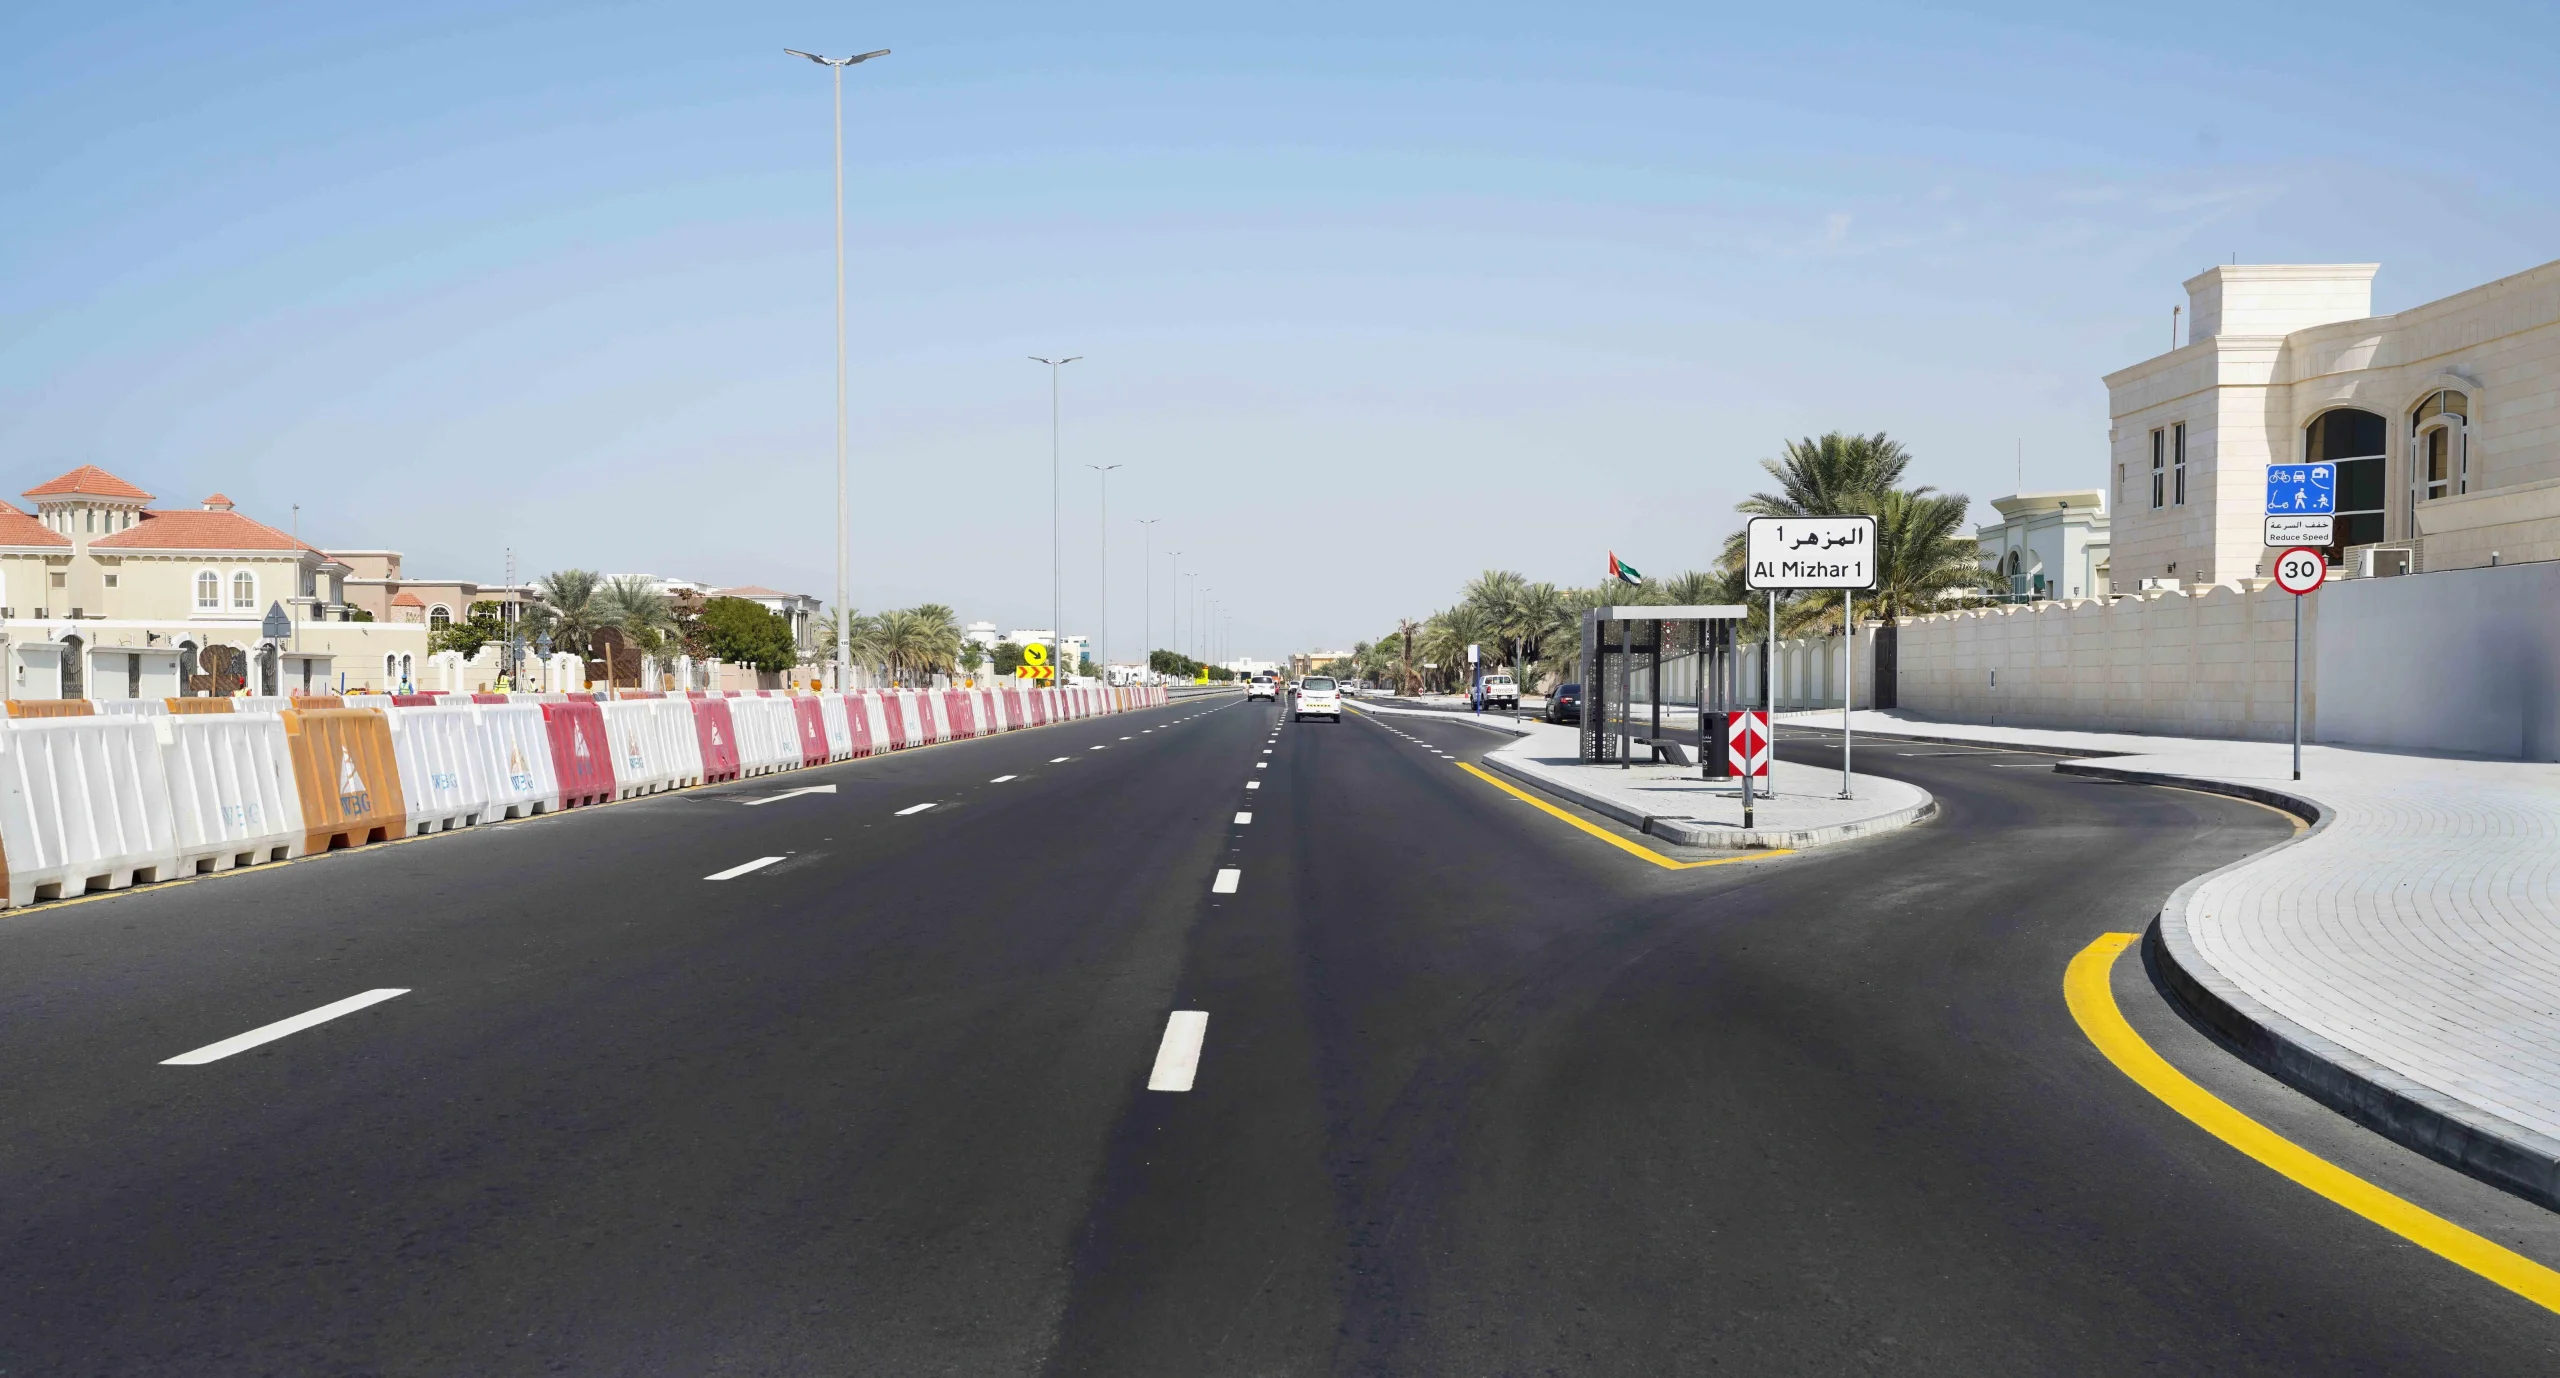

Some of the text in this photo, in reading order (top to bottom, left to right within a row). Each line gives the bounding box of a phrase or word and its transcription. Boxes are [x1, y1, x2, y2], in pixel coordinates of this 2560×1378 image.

[2270, 521, 2302, 530] السرعة
[1776, 526, 1863, 550] المزهر 1
[1754, 560, 1861, 578] Al Mizhar 1
[2285, 561, 2314, 578] 30
[339, 792, 371, 816] WBG
